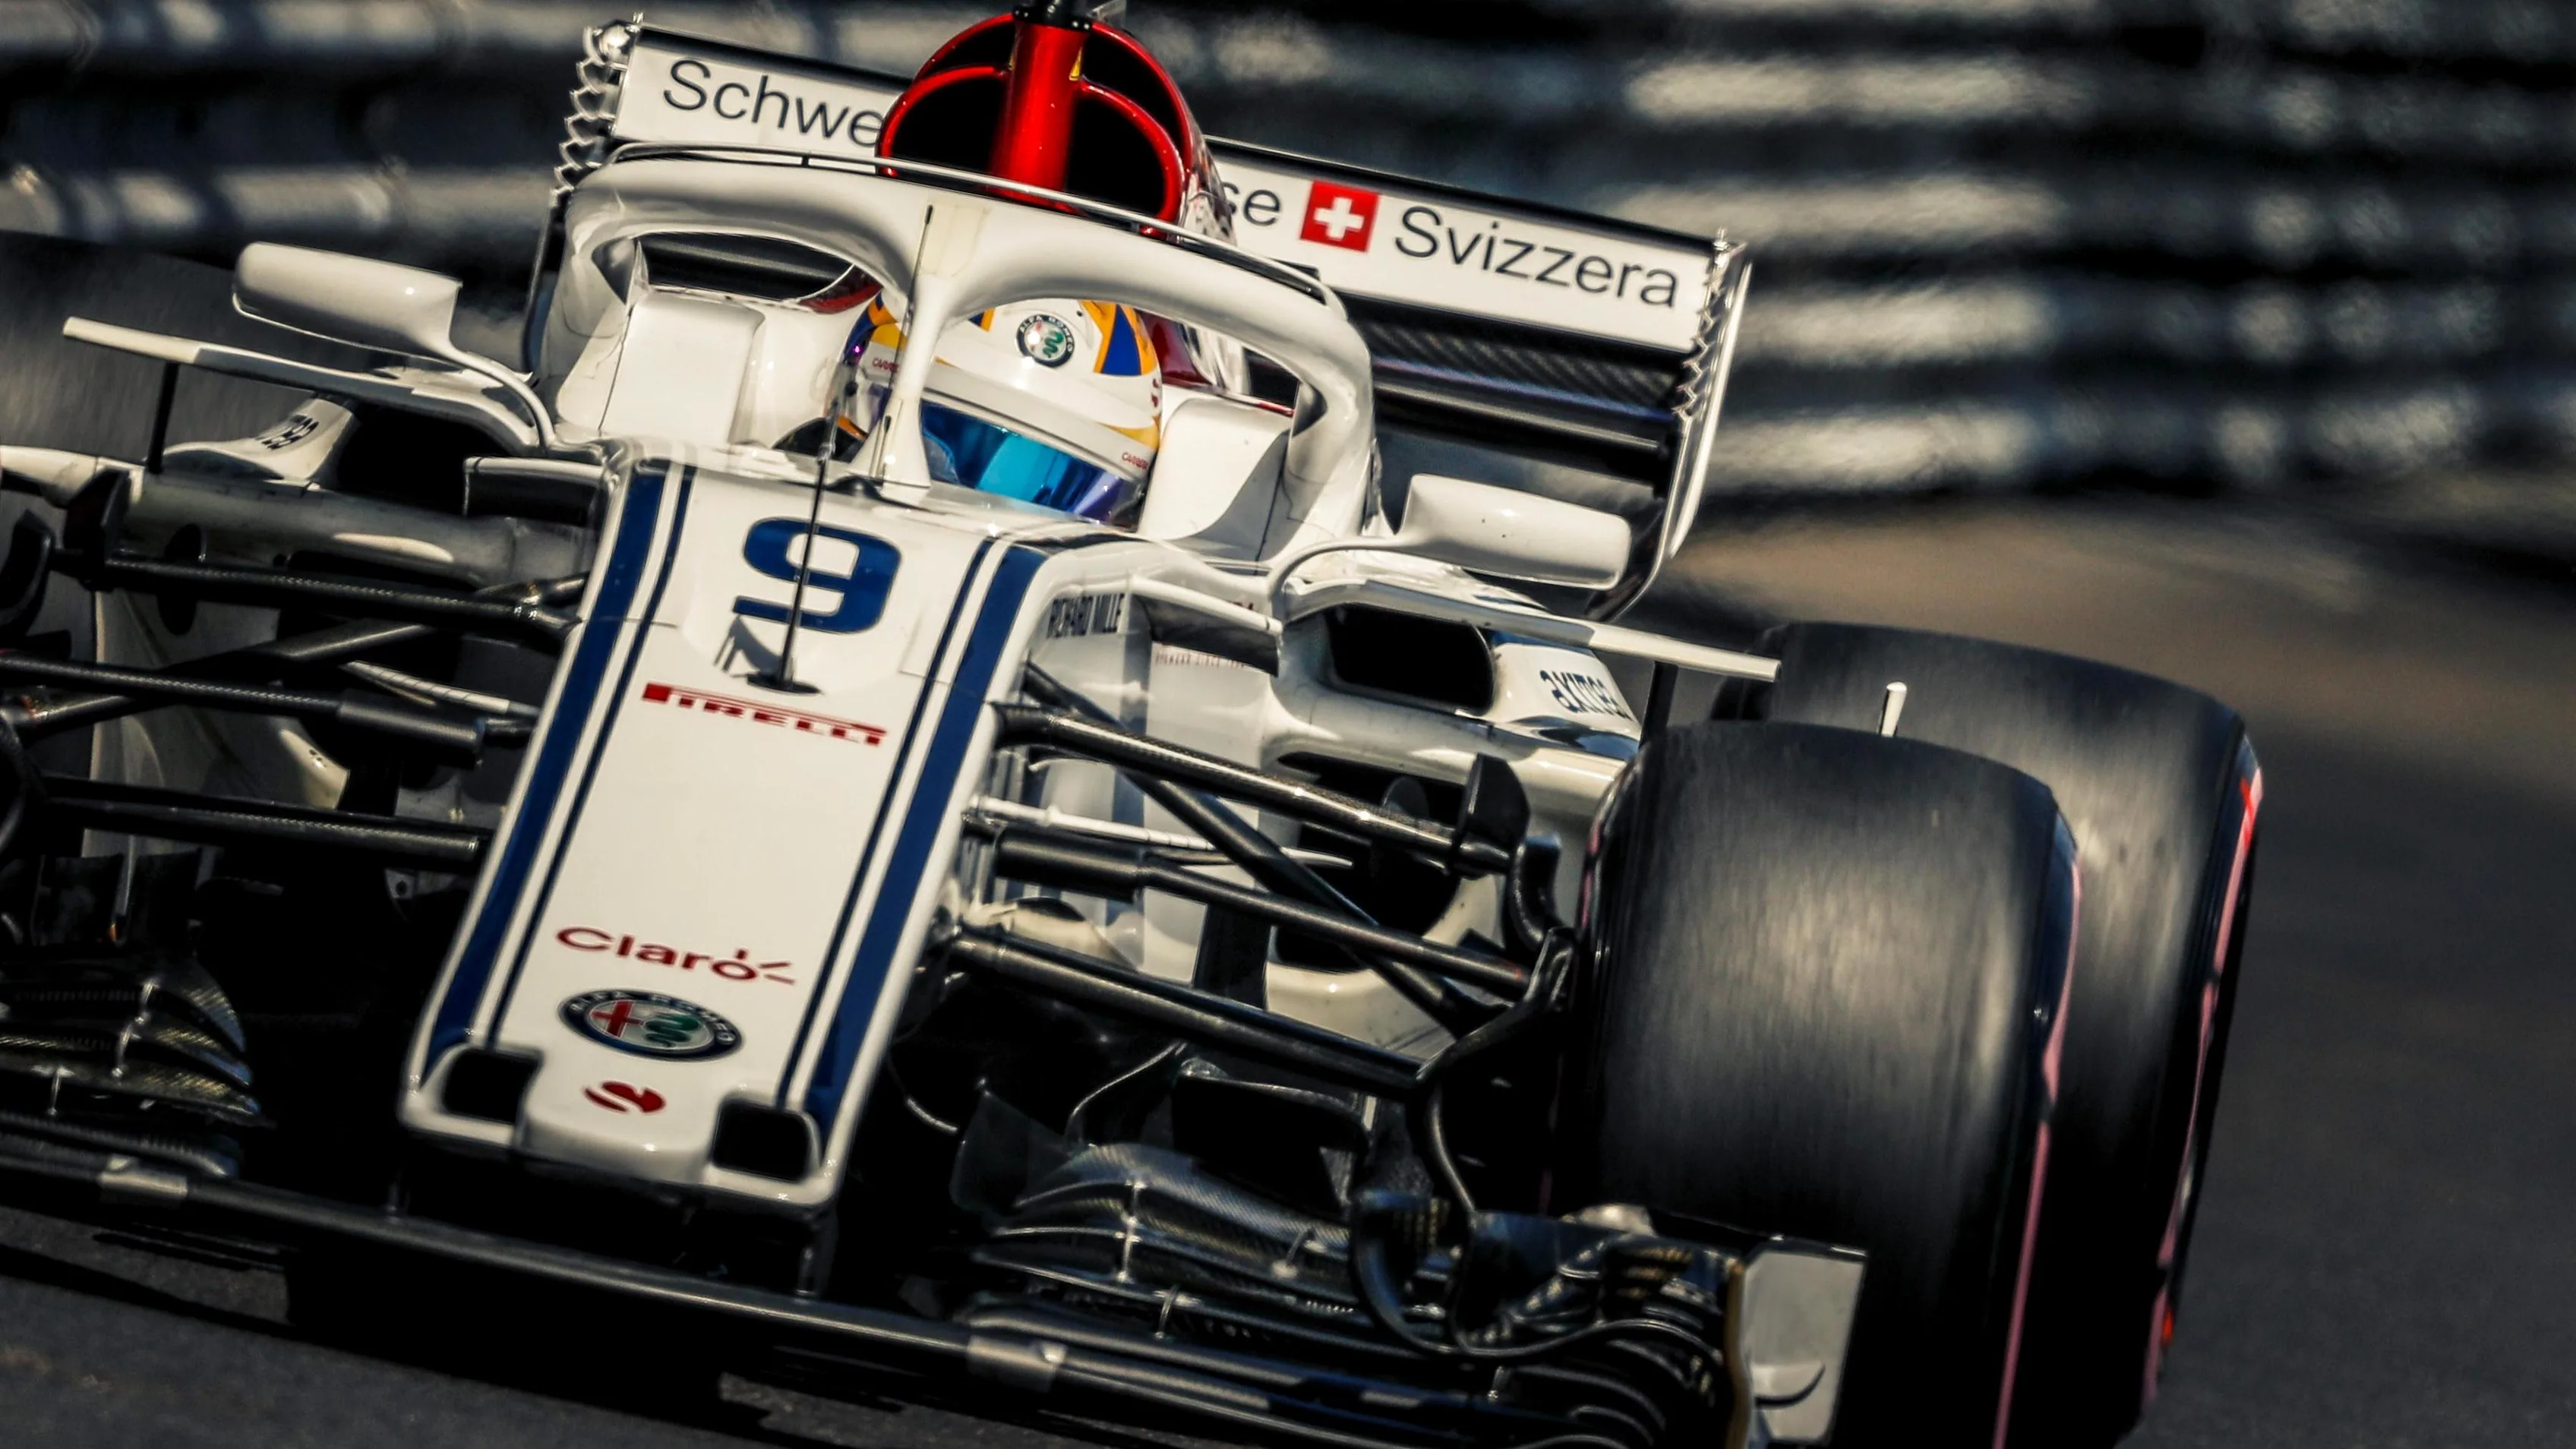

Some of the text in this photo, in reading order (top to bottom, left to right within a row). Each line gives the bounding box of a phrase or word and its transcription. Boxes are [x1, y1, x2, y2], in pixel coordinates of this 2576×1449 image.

[1395, 206, 1678, 308] Svizzera
[732, 516, 903, 635] 9
[642, 682, 887, 747] PIRELLI
[556, 926, 759, 981] Claro
